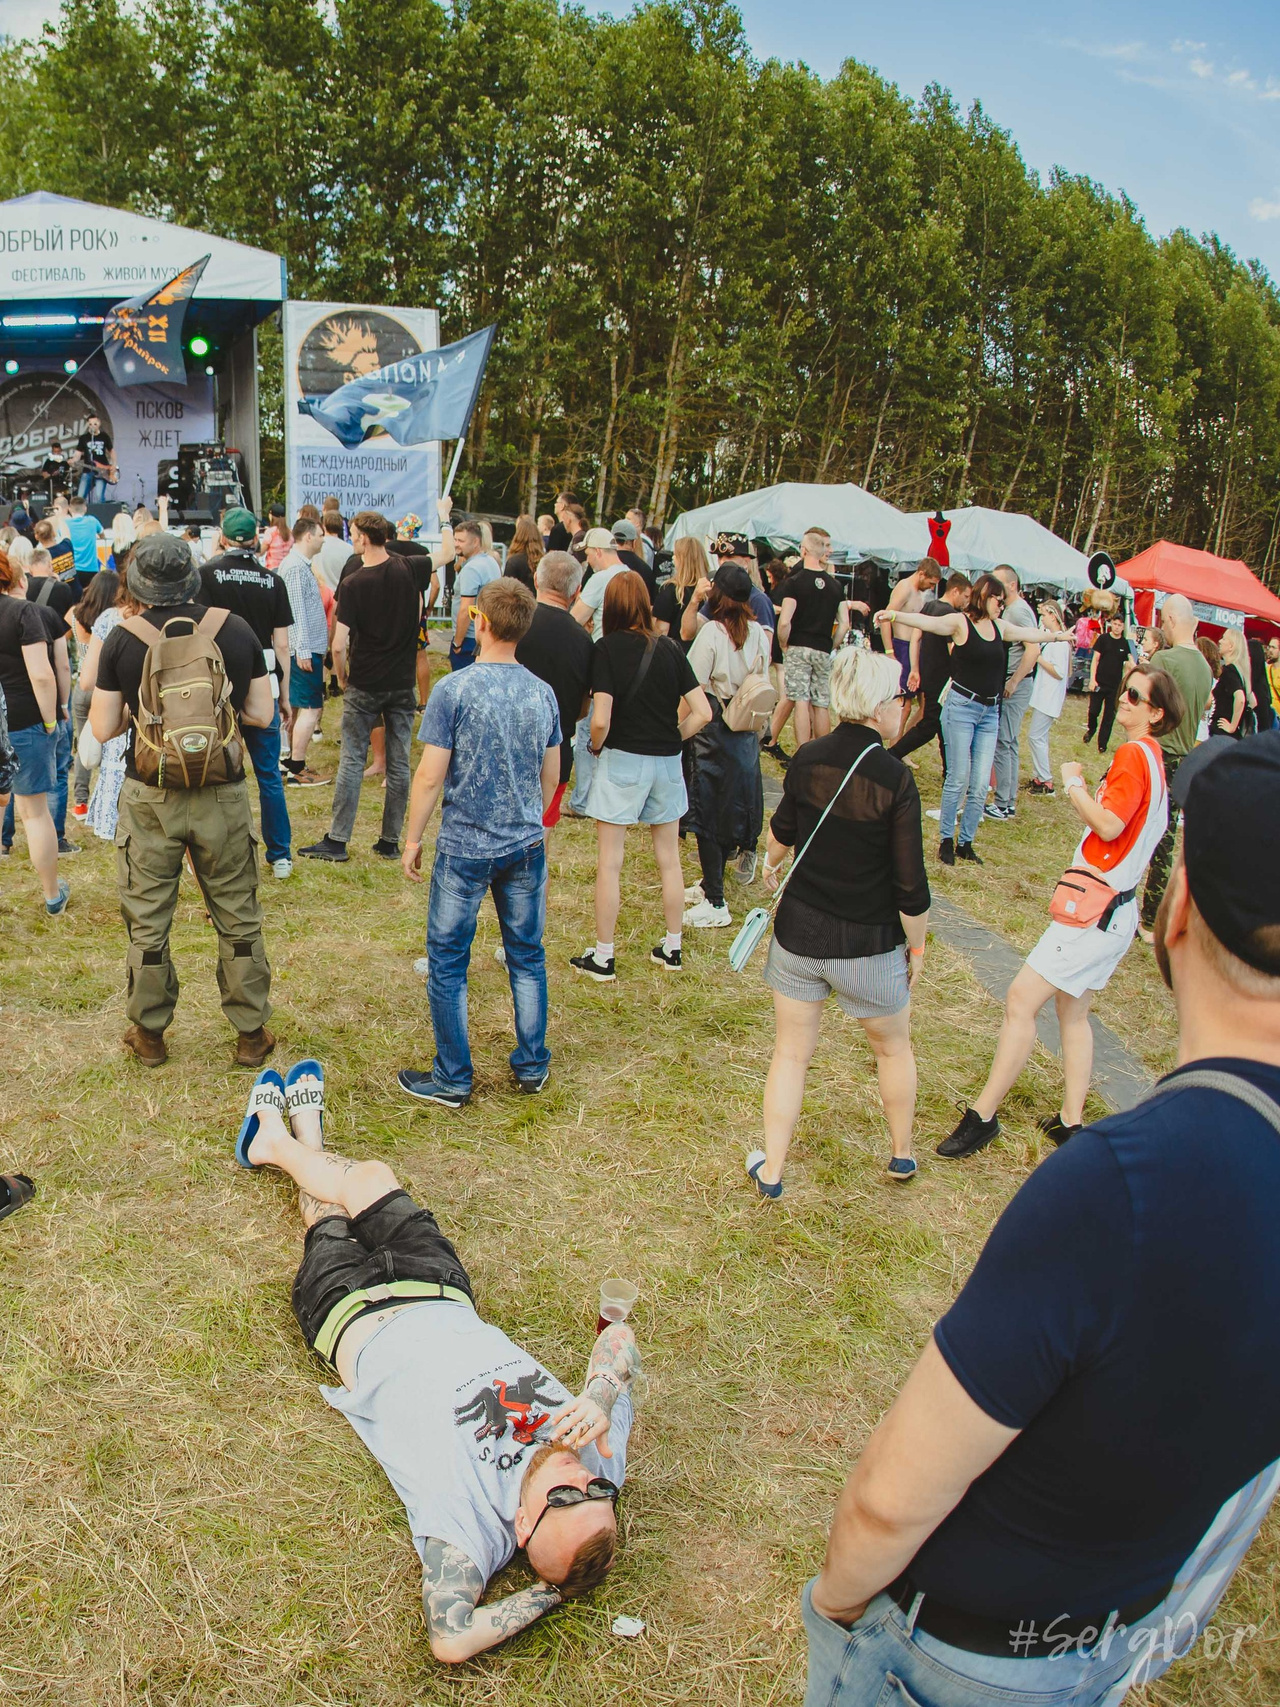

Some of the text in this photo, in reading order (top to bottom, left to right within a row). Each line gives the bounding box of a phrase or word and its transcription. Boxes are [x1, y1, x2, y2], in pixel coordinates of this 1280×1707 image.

[70, 228, 119, 251] РОК»
[12, 266, 86, 282] ФЕСТИВАЛЬ
[103, 265, 147, 281] ЖИВОЙ
[136, 401, 184, 419] ПСКОВ
[139, 429, 182, 449] ЖДЕТ
[301, 454, 408, 472] МЕЖДУНАРОДНЫЙ
[302, 472, 370, 488] ФЕСТИВАЛЬ
[346, 492, 395, 507] МУЗЫКИ
[255, 1090, 284, 1113] appa
[504, 1359, 522, 1368] CALL
[478, 1370, 491, 1378] THE
[455, 1378, 476, 1392] WILD
